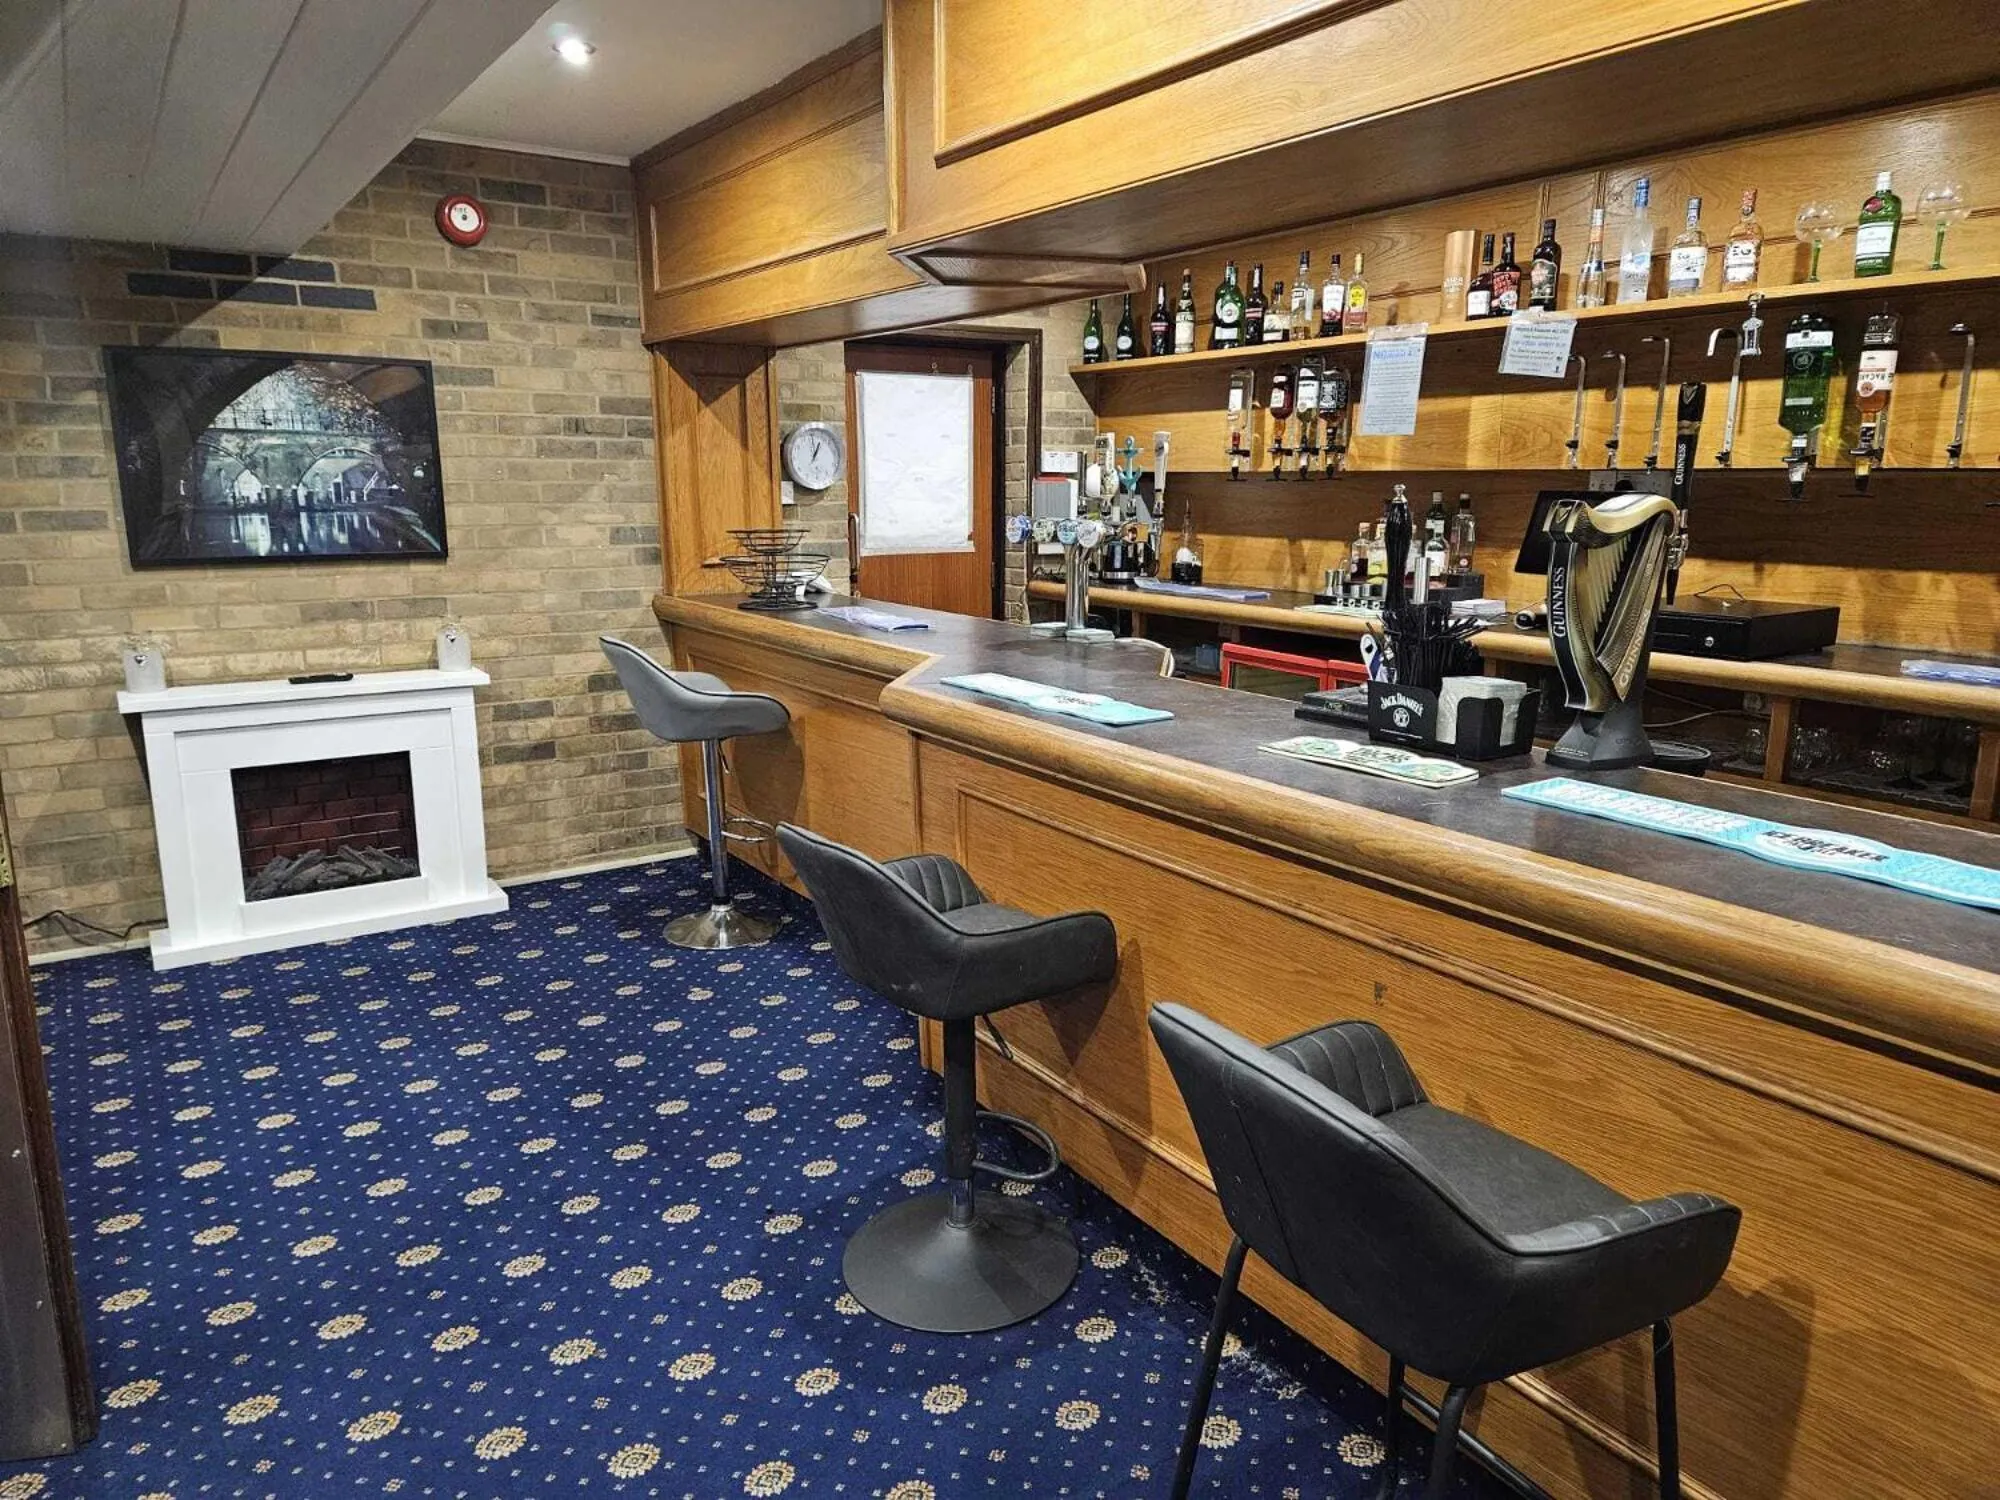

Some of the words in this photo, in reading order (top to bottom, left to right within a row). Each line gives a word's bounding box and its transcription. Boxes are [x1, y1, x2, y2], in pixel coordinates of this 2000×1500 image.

[1674, 443, 1687, 485] GUINNESS
[1552, 567, 1566, 638] GUINNESS
[1619, 608, 1651, 687] GUINNESS
[1380, 695, 1397, 710] JACK
[1396, 692, 1424, 718] DANIEL'S
